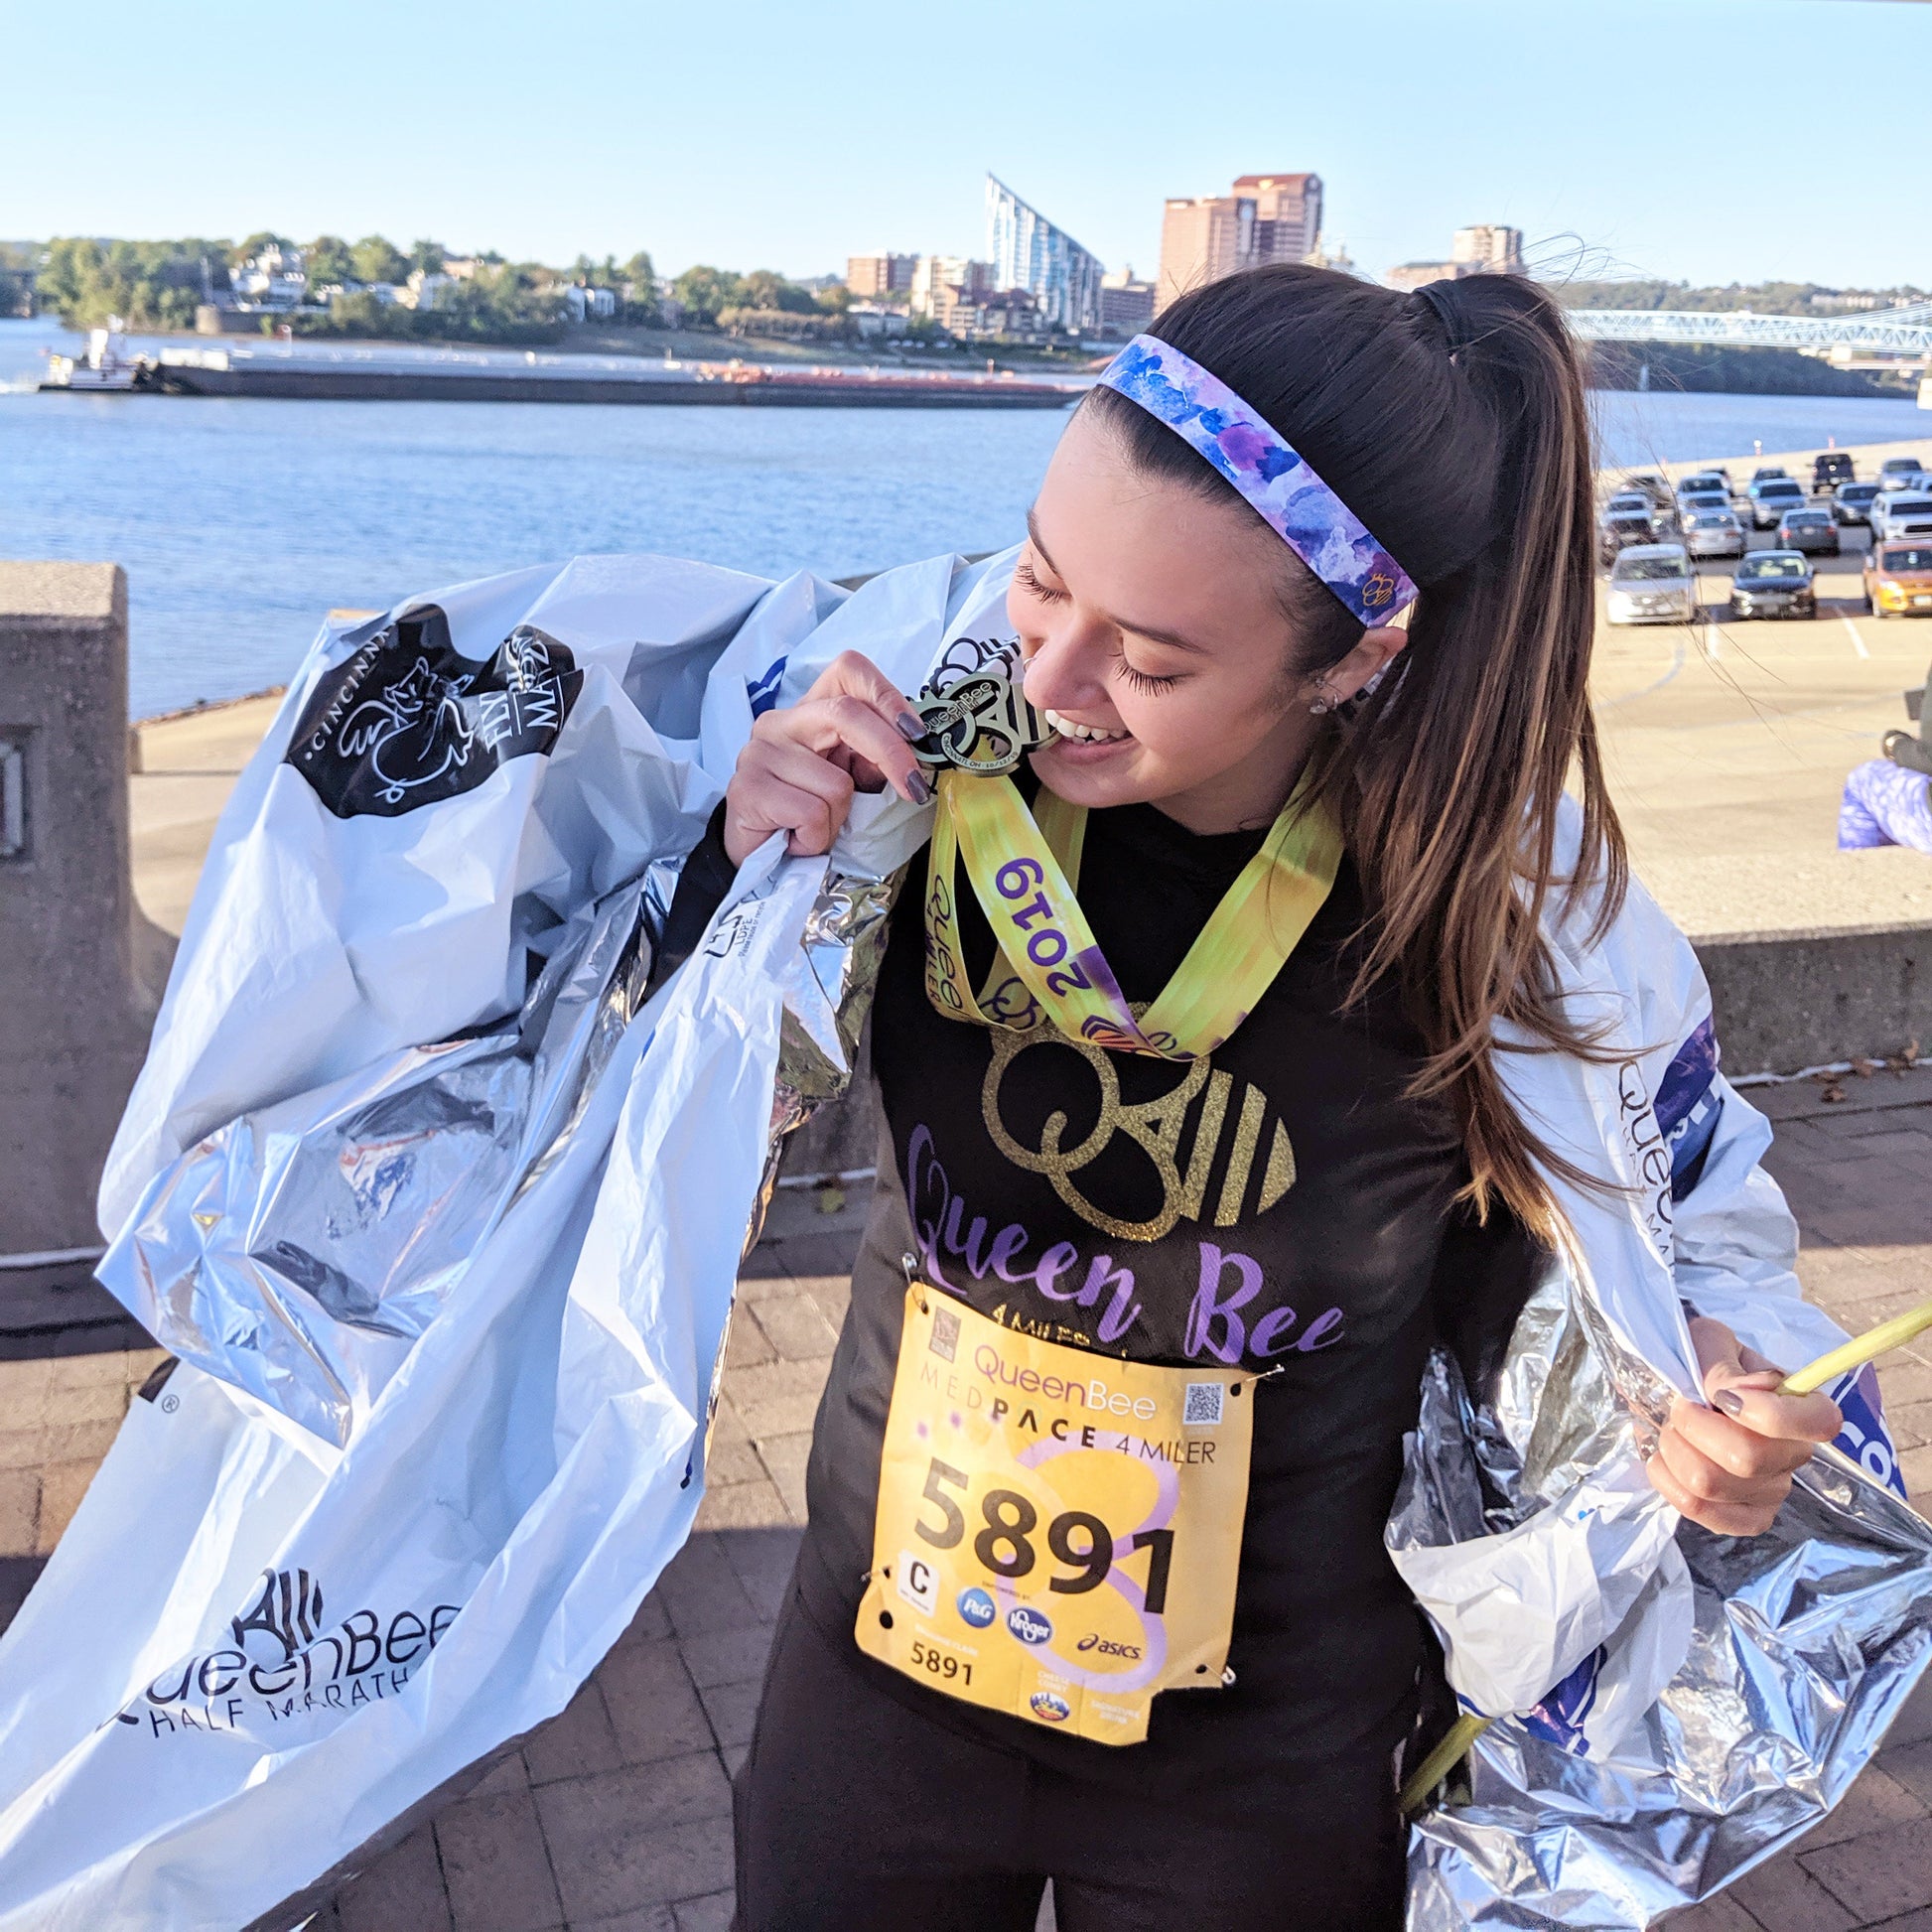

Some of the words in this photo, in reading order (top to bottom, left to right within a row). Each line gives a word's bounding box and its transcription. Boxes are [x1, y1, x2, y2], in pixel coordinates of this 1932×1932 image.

[996, 857, 1092, 998] 2019
[905, 1123, 1143, 1344] Queen
[1184, 1241, 1346, 1364] Bee
[974, 1344, 1158, 1422] QueenBee
[1115, 1438, 1132, 1456] 4
[1140, 1439, 1216, 1465] MILER
[913, 1456, 1175, 1615] 5891
[909, 1561, 930, 1594] C
[963, 1597, 992, 1620] P&G
[1009, 1608, 1051, 1642] Kroger
[910, 1640, 973, 1687] 5891
[148, 1698, 245, 1738] HALF
